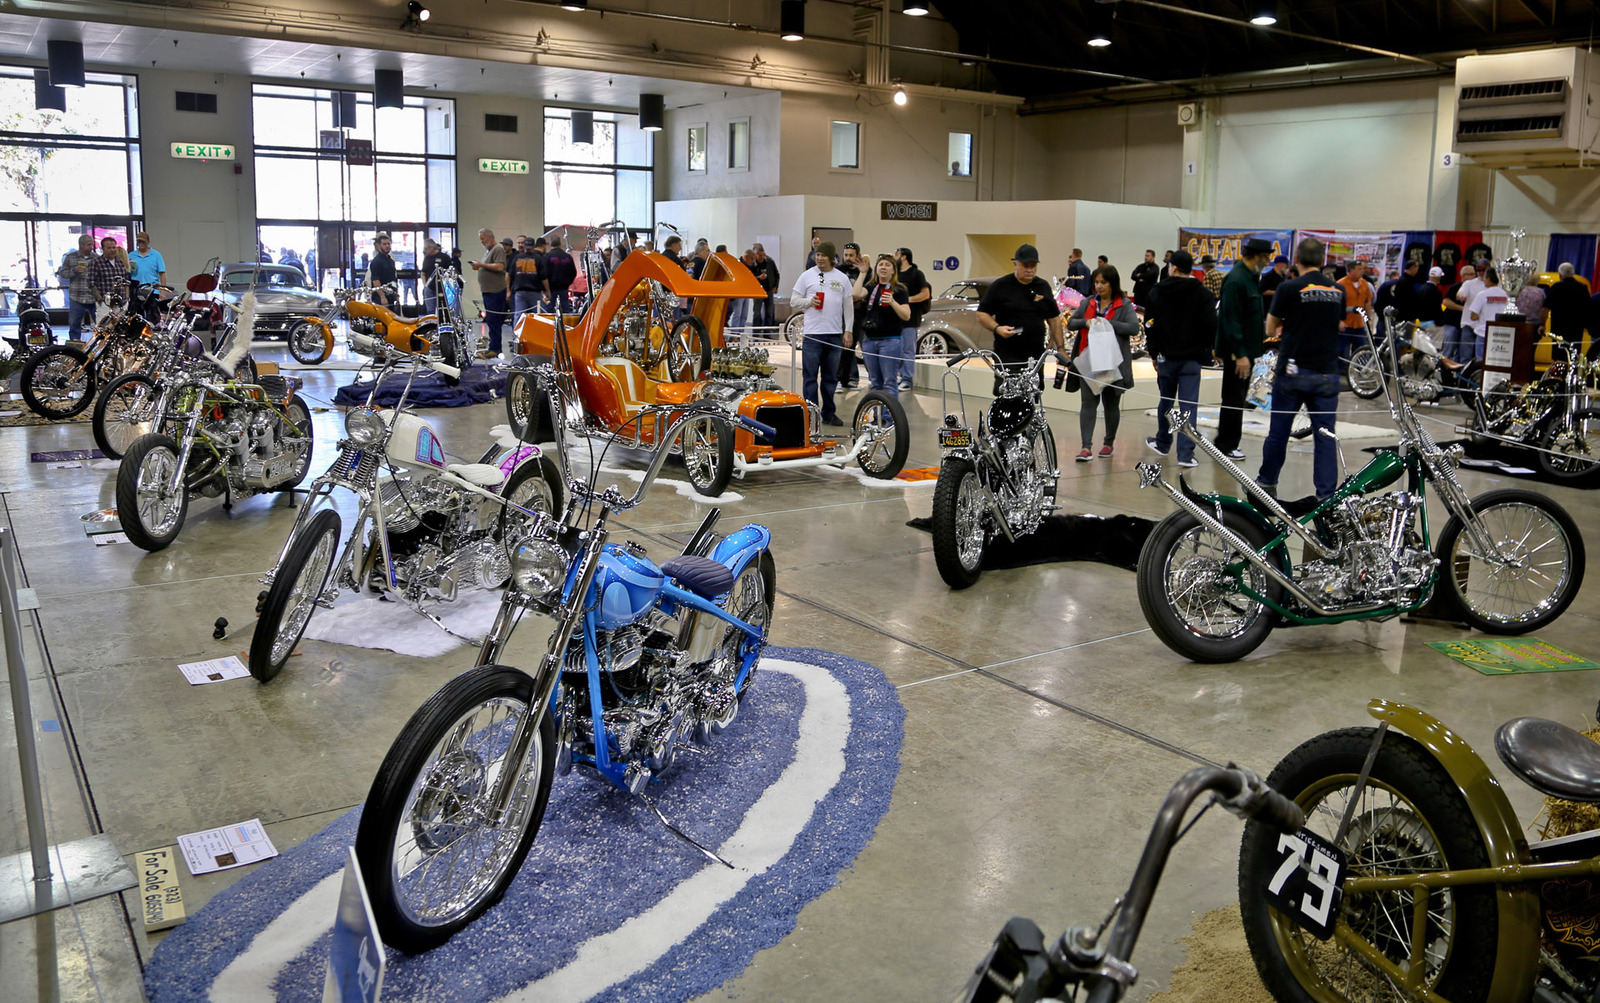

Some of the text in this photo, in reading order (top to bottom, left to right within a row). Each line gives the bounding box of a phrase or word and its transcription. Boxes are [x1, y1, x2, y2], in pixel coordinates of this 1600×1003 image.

[186, 146, 221, 157] EXIT
[491, 161, 518, 171] EXIT
[1443, 155, 1451, 166] 3
[1188, 164, 1193, 173] 1
[887, 204, 931, 218] WOMEN
[1188, 238, 1282, 260] CATALA
[142, 851, 167, 868] For
[145, 869, 168, 892] Sale
[1268, 833, 1340, 928] 79
